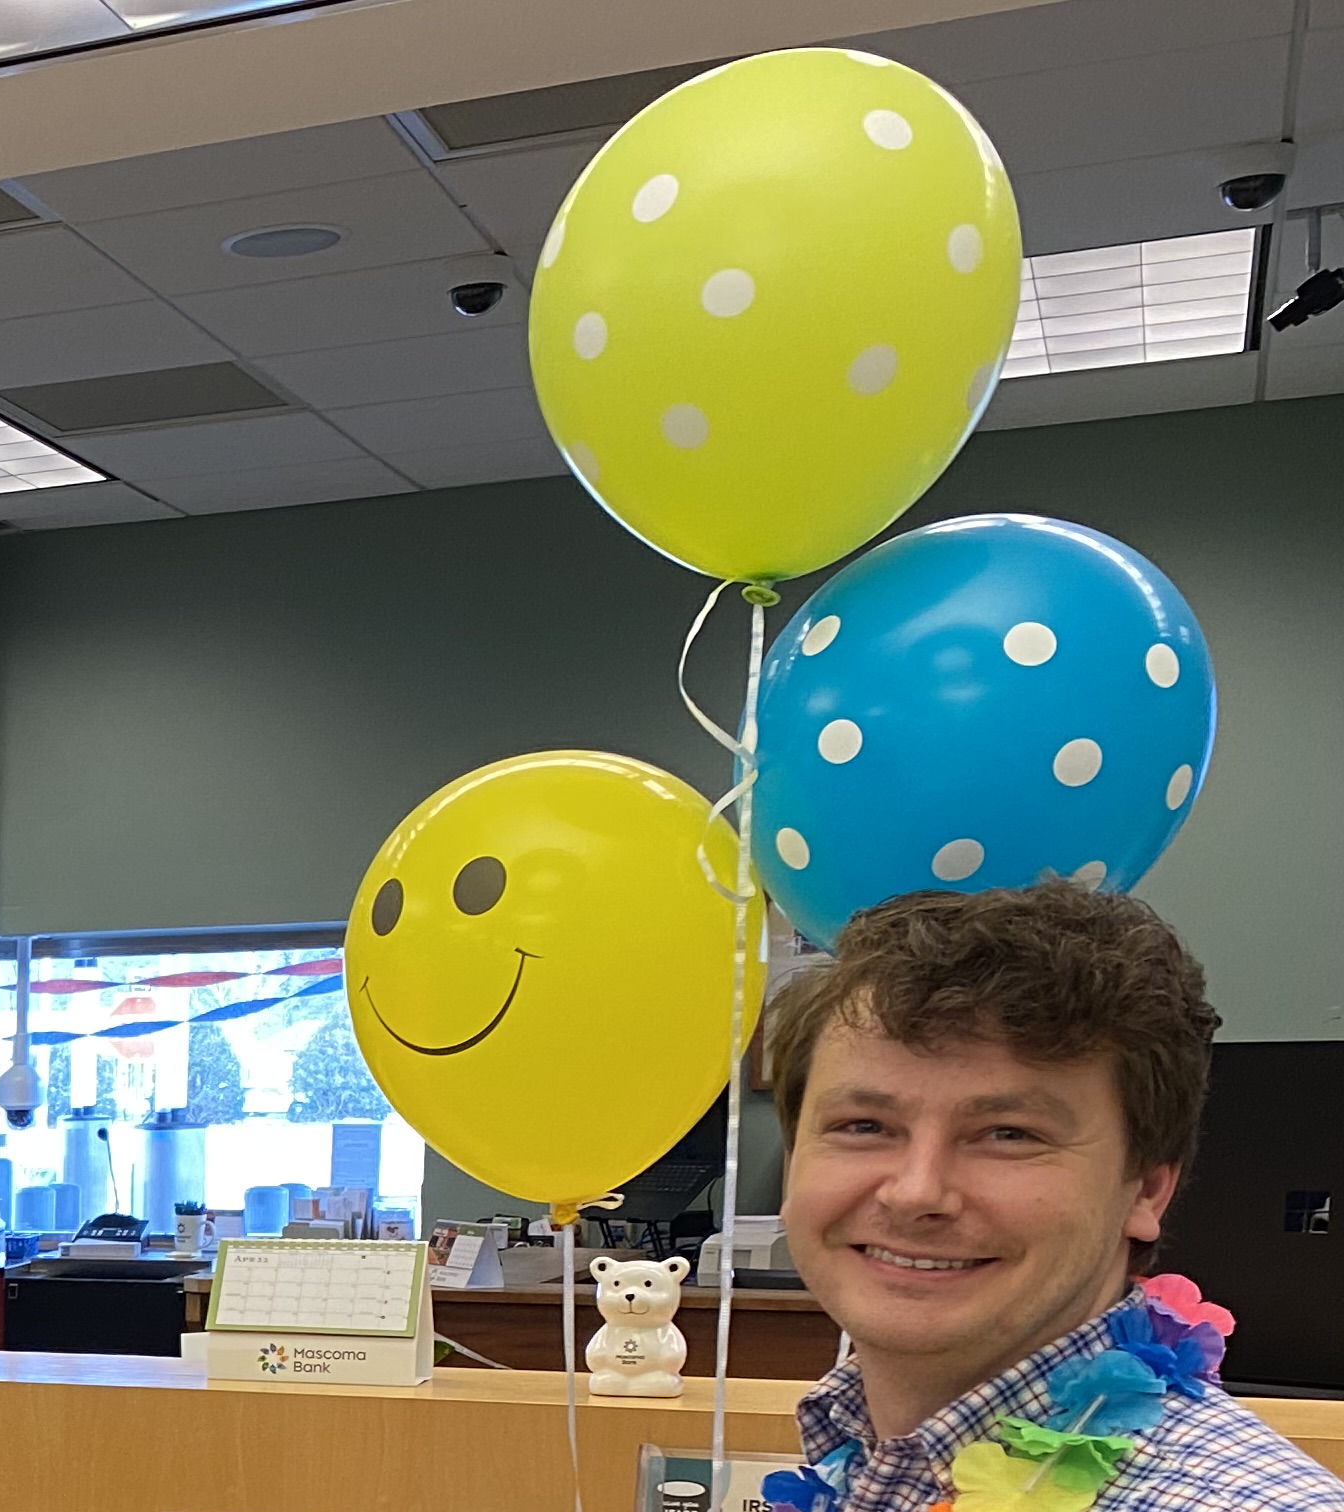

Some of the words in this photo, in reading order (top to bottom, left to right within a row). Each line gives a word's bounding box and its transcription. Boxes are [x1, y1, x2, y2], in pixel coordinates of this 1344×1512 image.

[293, 1347, 367, 1361] Mascoma
[293, 1361, 331, 1373] Bank
[742, 1499, 774, 1512] IRS
